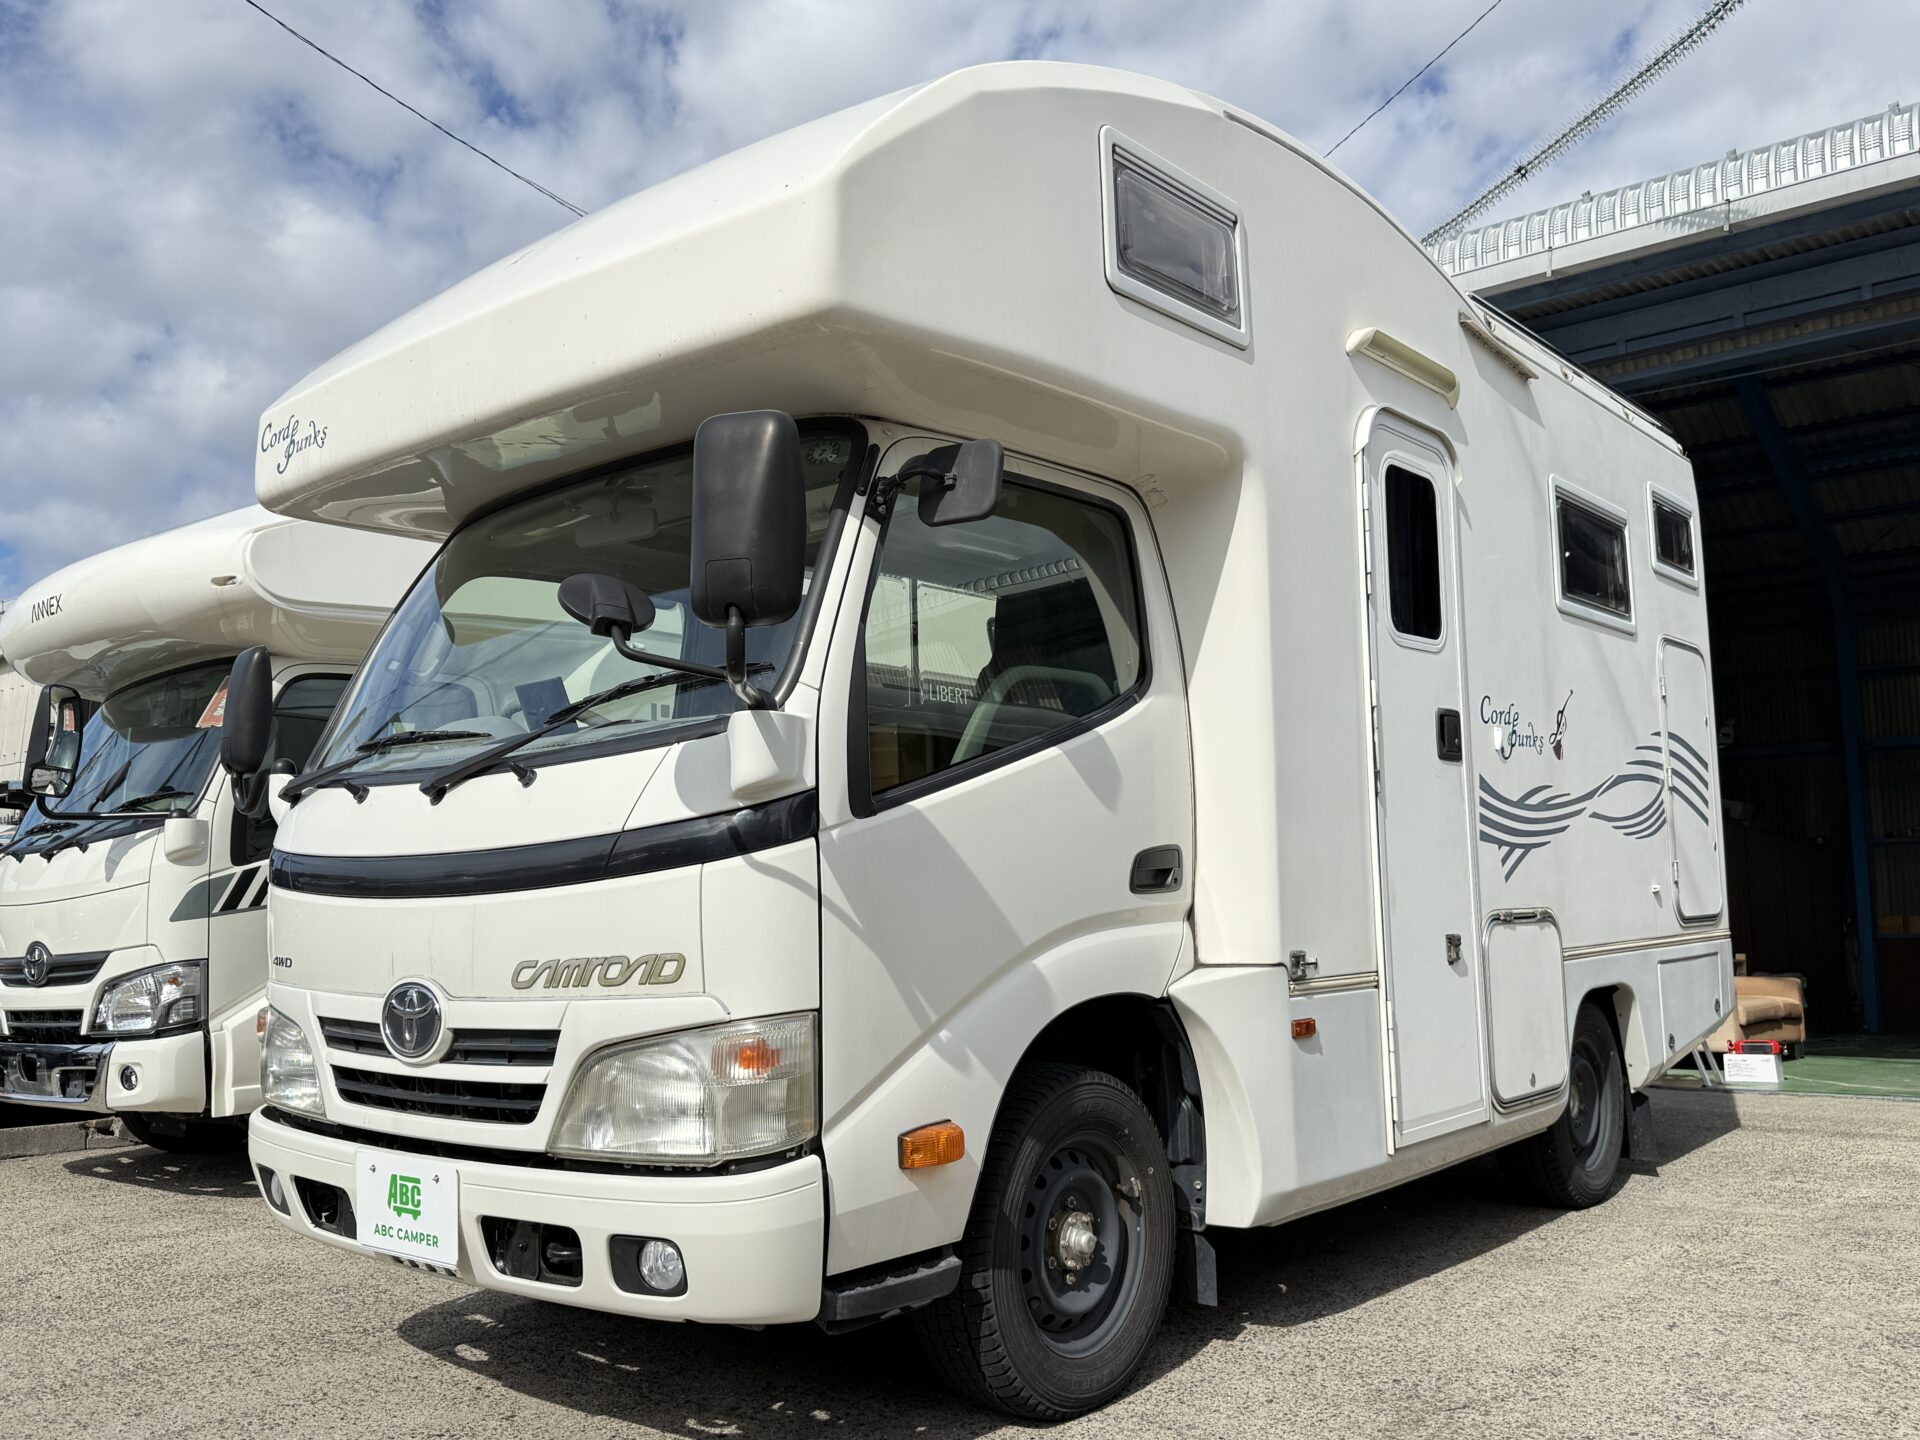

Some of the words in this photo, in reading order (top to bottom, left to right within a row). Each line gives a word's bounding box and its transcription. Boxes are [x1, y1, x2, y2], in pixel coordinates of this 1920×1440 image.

[261, 414, 299, 453] Corde
[31, 593, 63, 623] ANNEX
[1480, 695, 1519, 728] Corde
[273, 956, 293, 968] 4WD
[387, 1173, 421, 1210] ABC
[373, 1223, 394, 1237] ABC
[396, 1228, 439, 1248] CAMPER
